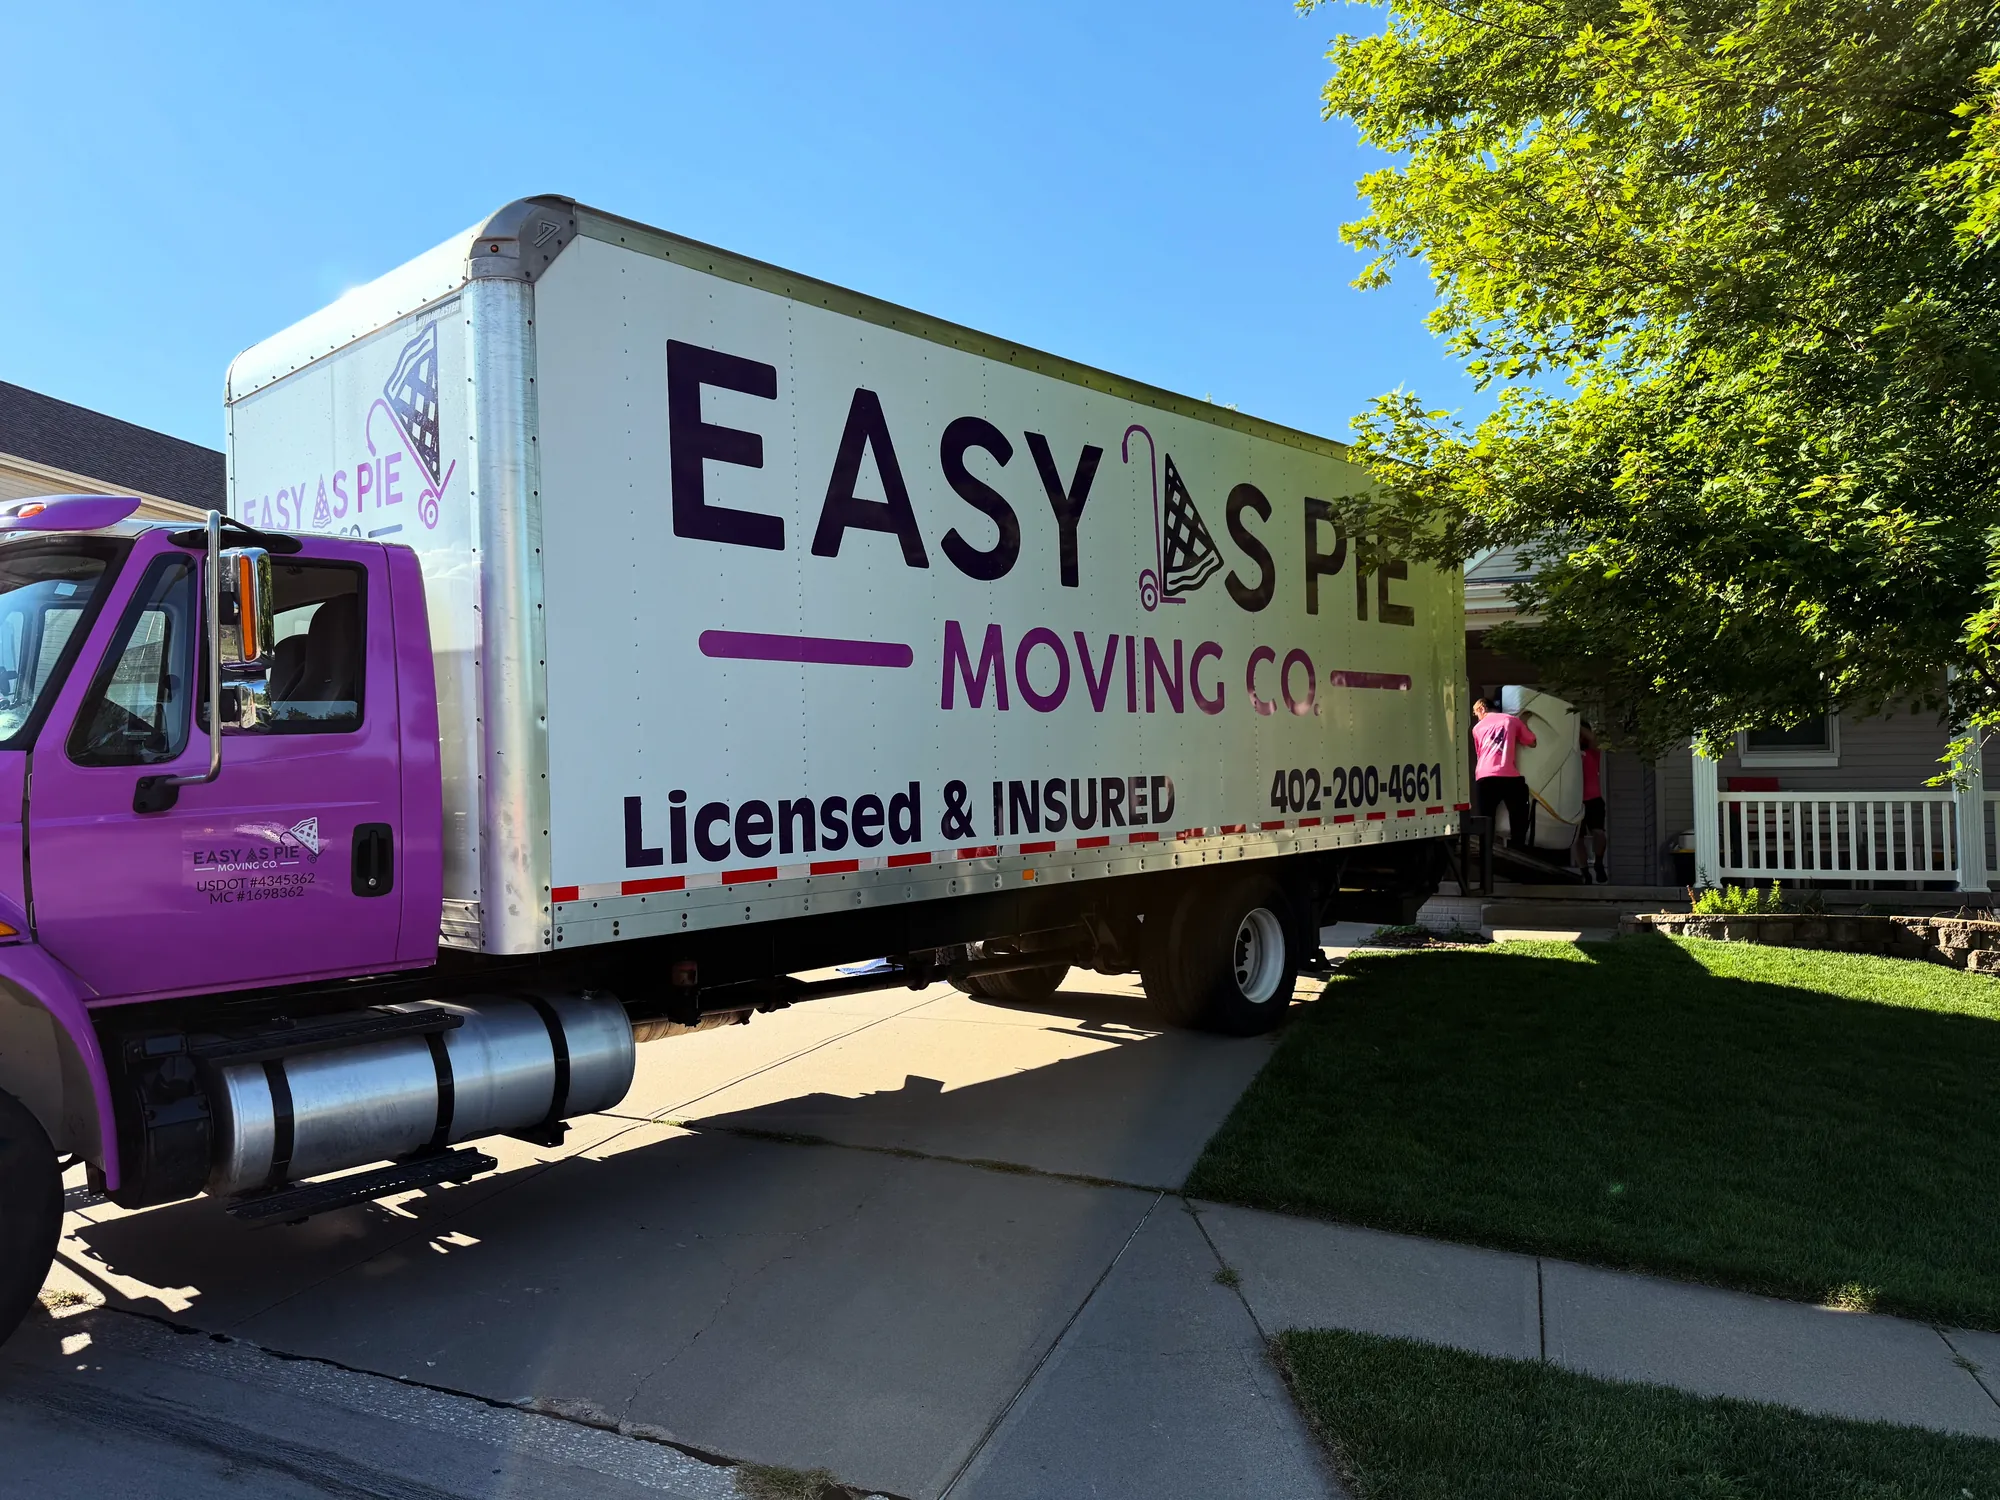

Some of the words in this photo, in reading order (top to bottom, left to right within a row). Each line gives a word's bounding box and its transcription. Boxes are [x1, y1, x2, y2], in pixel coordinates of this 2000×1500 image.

[357, 451, 403, 513] PIE
[667, 338, 1104, 588] EASY
[1304, 496, 1415, 627] PIE
[941, 620, 1226, 715] MOVING
[1246, 645, 1322, 717] CO.
[1270, 762, 1442, 814] 402-200-4661
[623, 780, 922, 868] Licensed
[940, 780, 974, 840] &
[992, 775, 1176, 836] INSURED
[193, 849, 242, 865] EASY
[274, 845, 300, 860] PIE
[217, 861, 260, 873] MOVING
[262, 860, 278, 869] CO.
[196, 877, 247, 893] USDOT
[249, 872, 316, 888] #4345362
[209, 891, 234, 905] MC
[236, 885, 305, 902] #1698362
